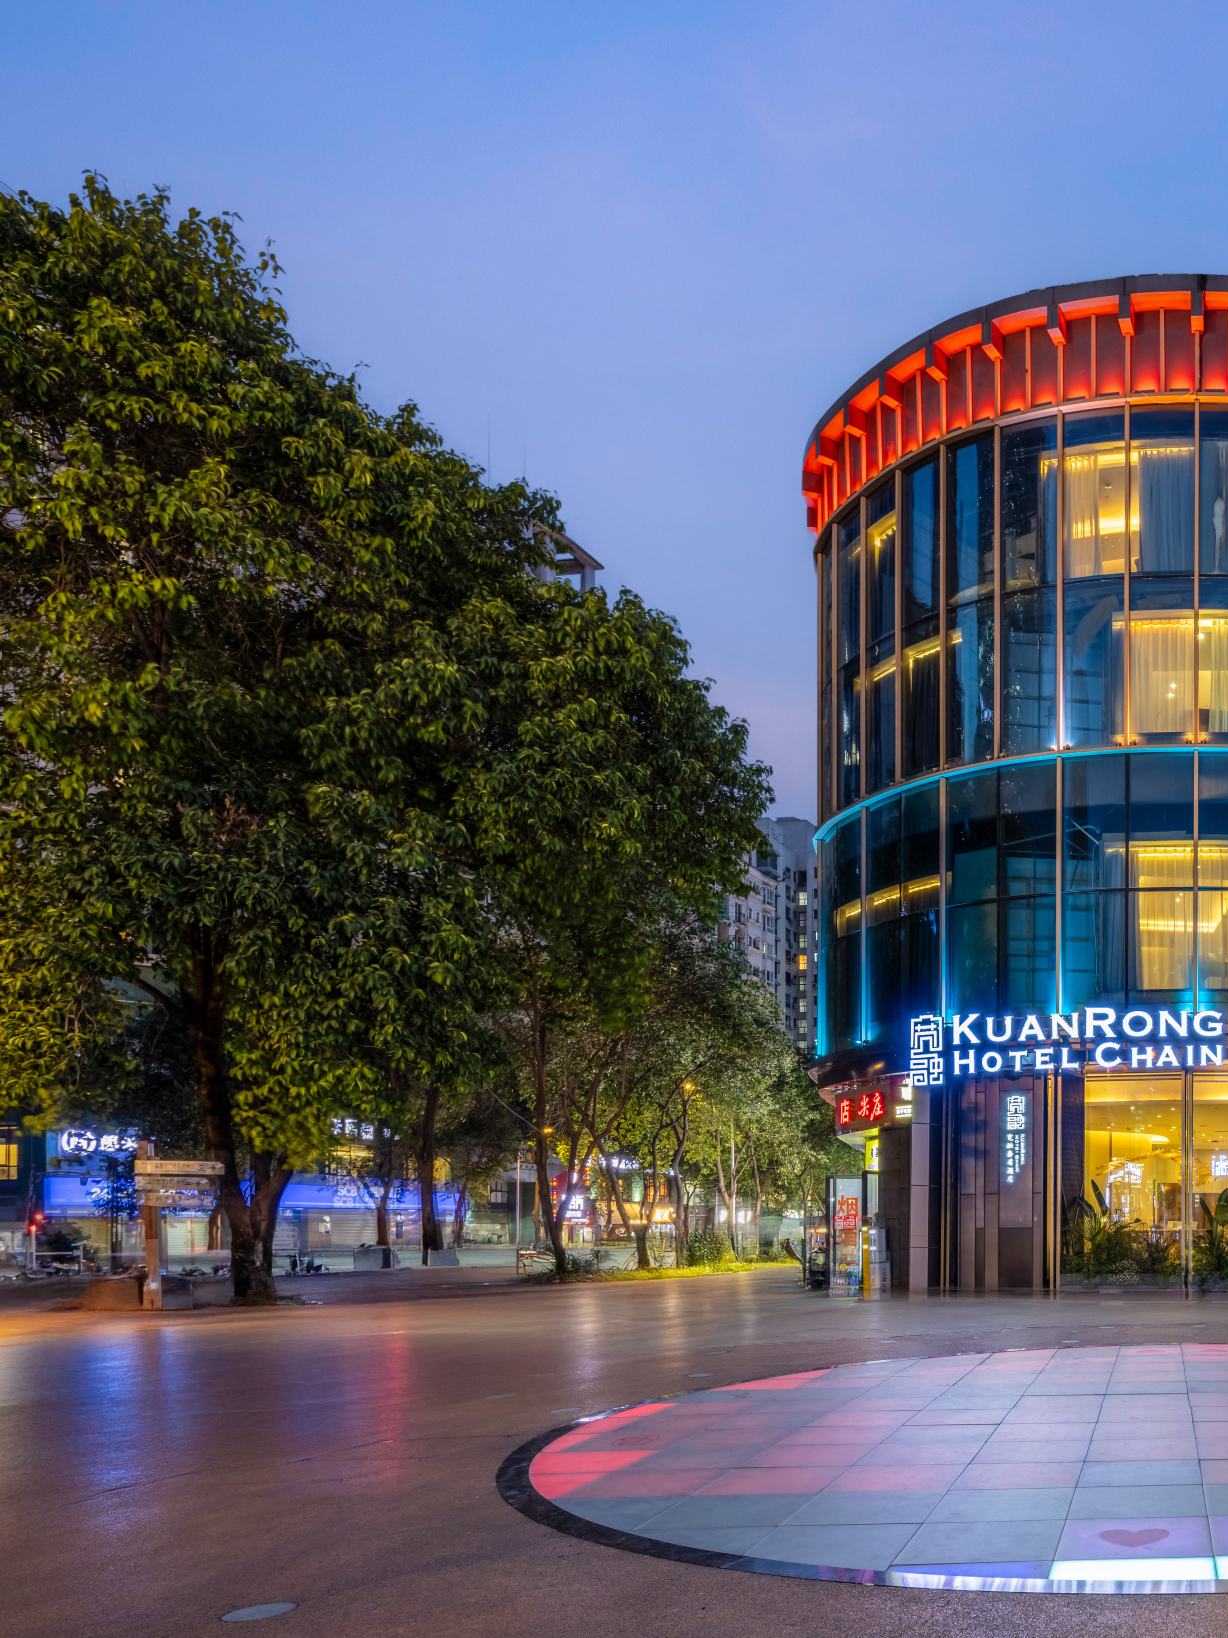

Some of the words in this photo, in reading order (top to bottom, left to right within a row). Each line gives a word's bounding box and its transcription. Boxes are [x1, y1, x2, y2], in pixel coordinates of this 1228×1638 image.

[953, 1048, 1080, 1076] HOTEL
[1095, 1041, 1224, 1069] CHAIN
[839, 1099, 851, 1125] 店
[857, 1092, 885, 1122] 尖庄
[836, 1195, 859, 1217] 烟
